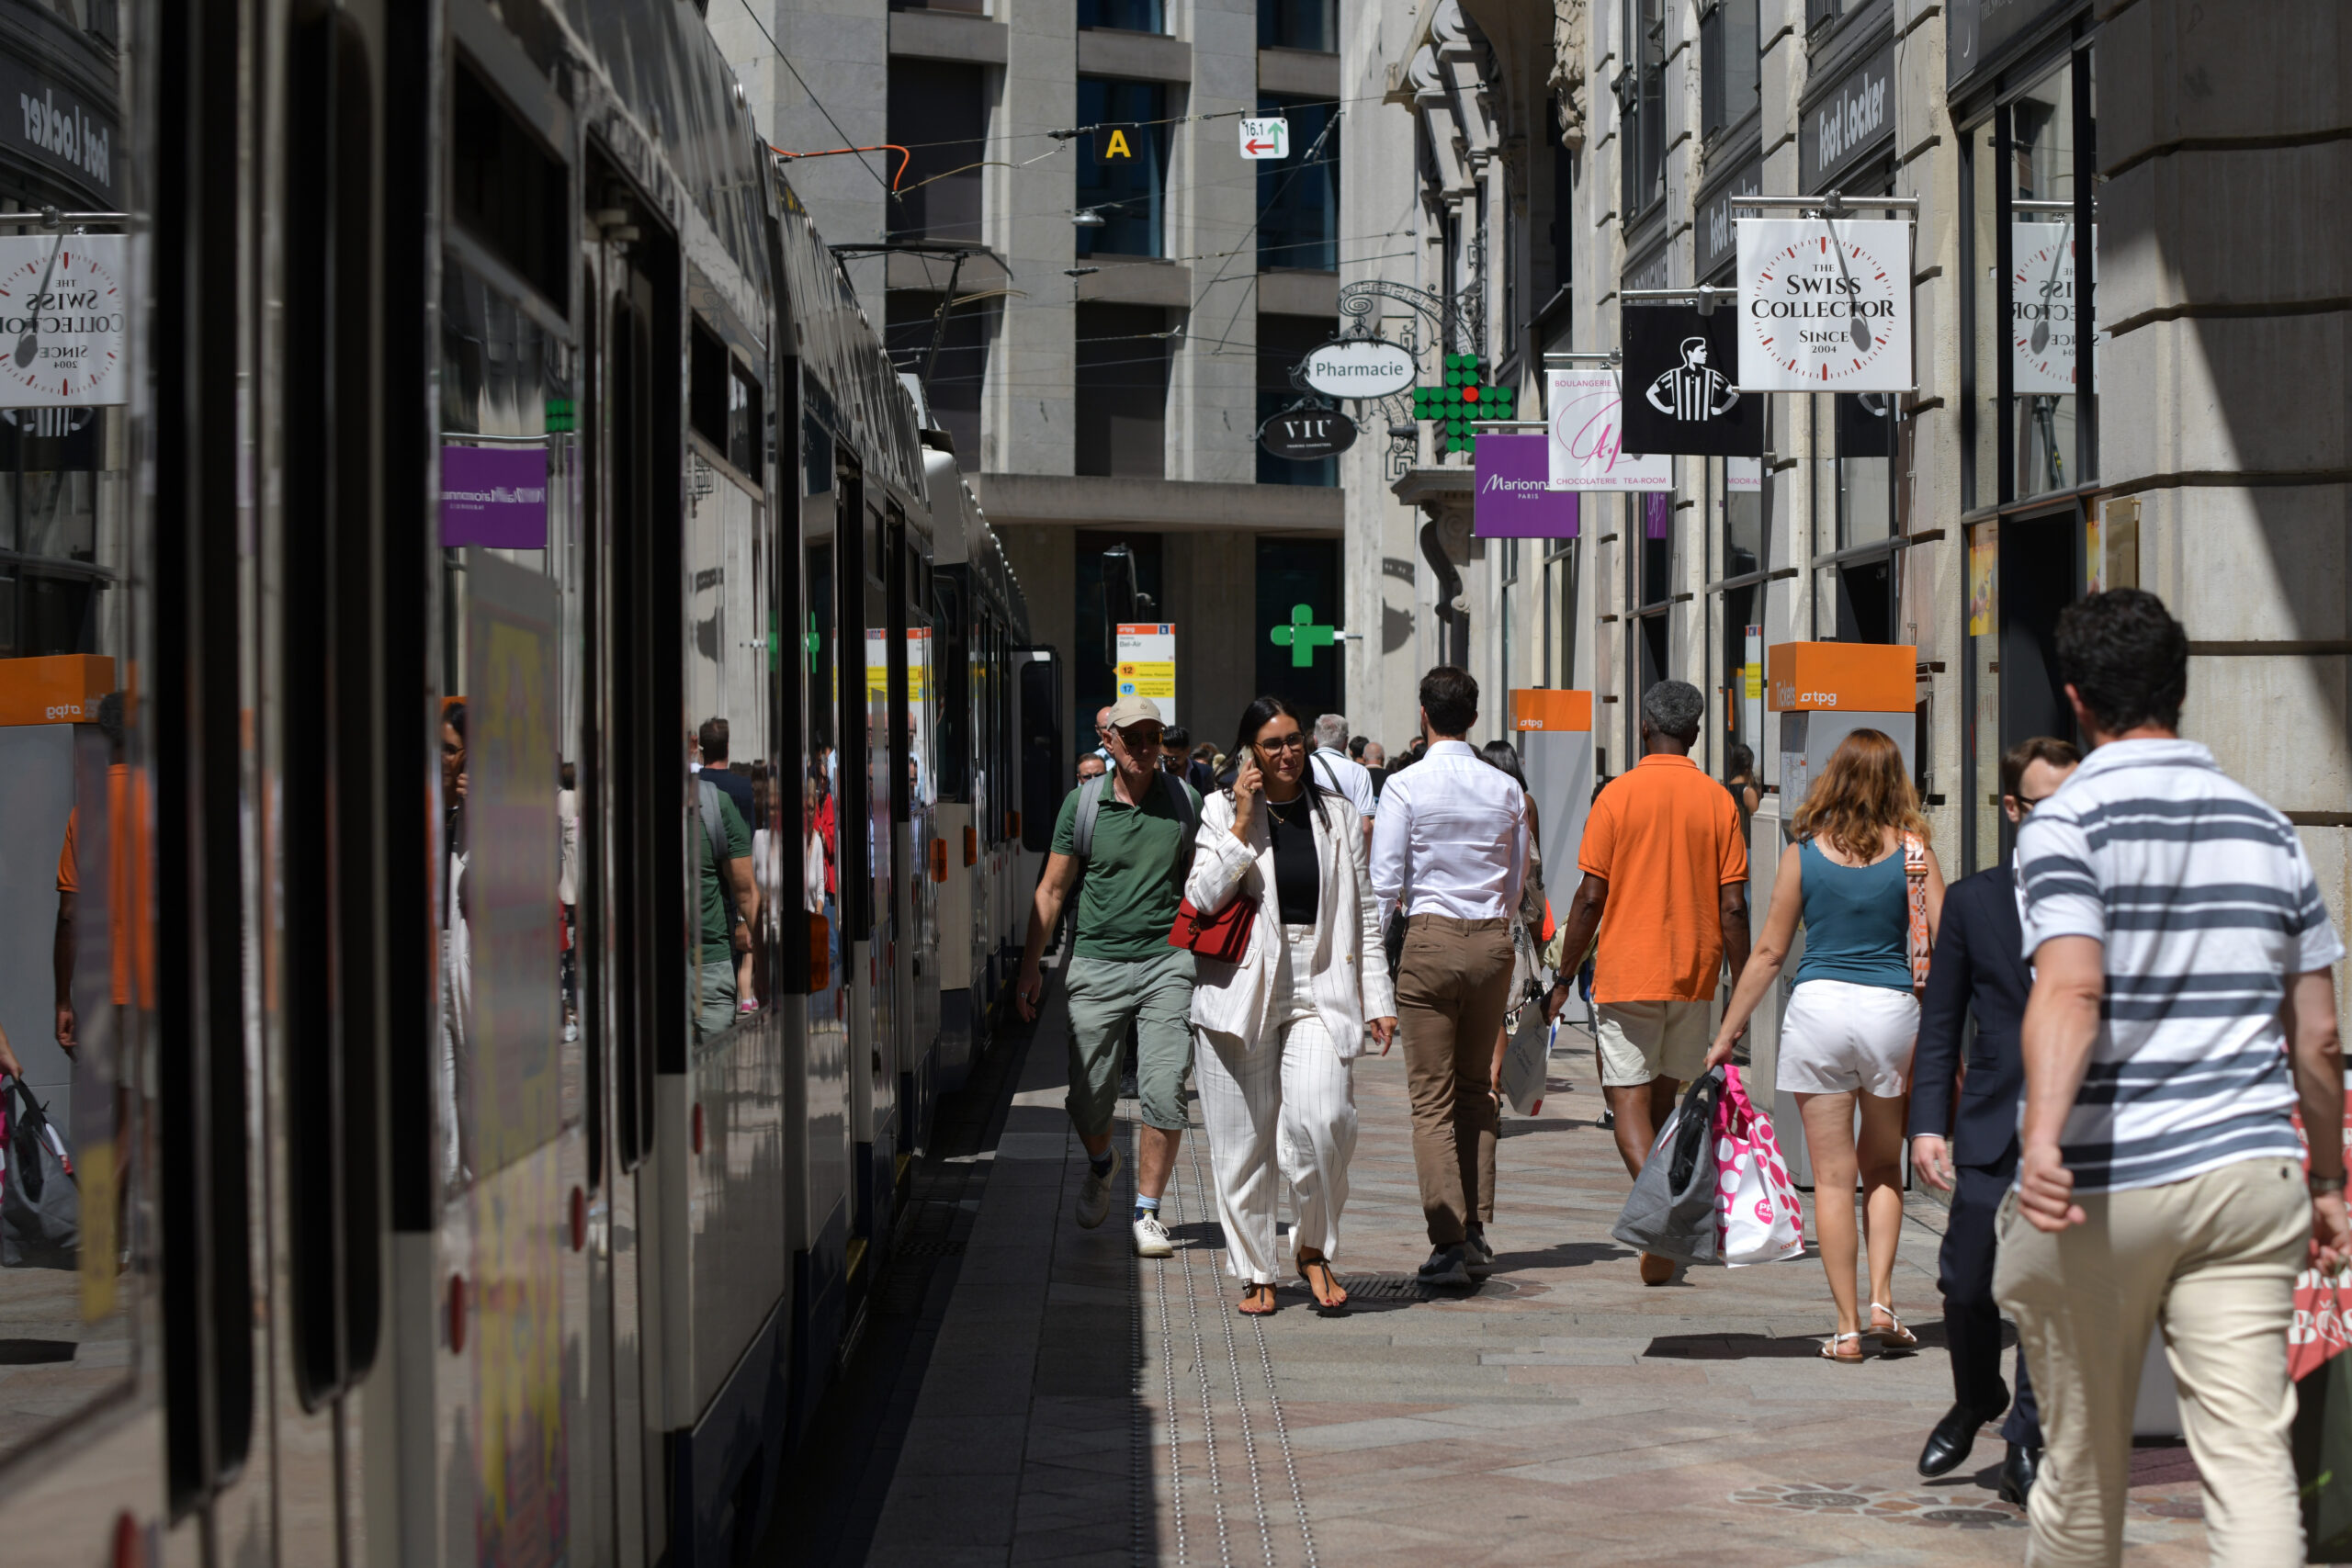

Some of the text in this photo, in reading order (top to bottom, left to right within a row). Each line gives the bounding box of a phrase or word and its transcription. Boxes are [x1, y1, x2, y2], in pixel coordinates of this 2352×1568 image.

[1245, 122, 1263, 136] 16.1
[1819, 73, 1885, 171] Foot Locker
[1105, 130, 1131, 158] A
[1710, 198, 1727, 258] Foot
[1812, 264, 1835, 272] THE
[1786, 275, 1861, 295] SWISS
[1751, 299, 1895, 318] COLLECTOR
[1799, 330, 1849, 343] SINCE
[1316, 361, 1404, 377] Pharmacie
[1482, 473, 1549, 494] Marionn
[1555, 477, 1667, 485] CHOCOLATERIE TEA-ROOM
[1124, 666, 1133, 674] 12
[1124, 684, 1132, 693] 17
[1776, 678, 1795, 708] Tickets
[1813, 691, 1837, 706] tpg
[1527, 718, 1544, 728] tpg
